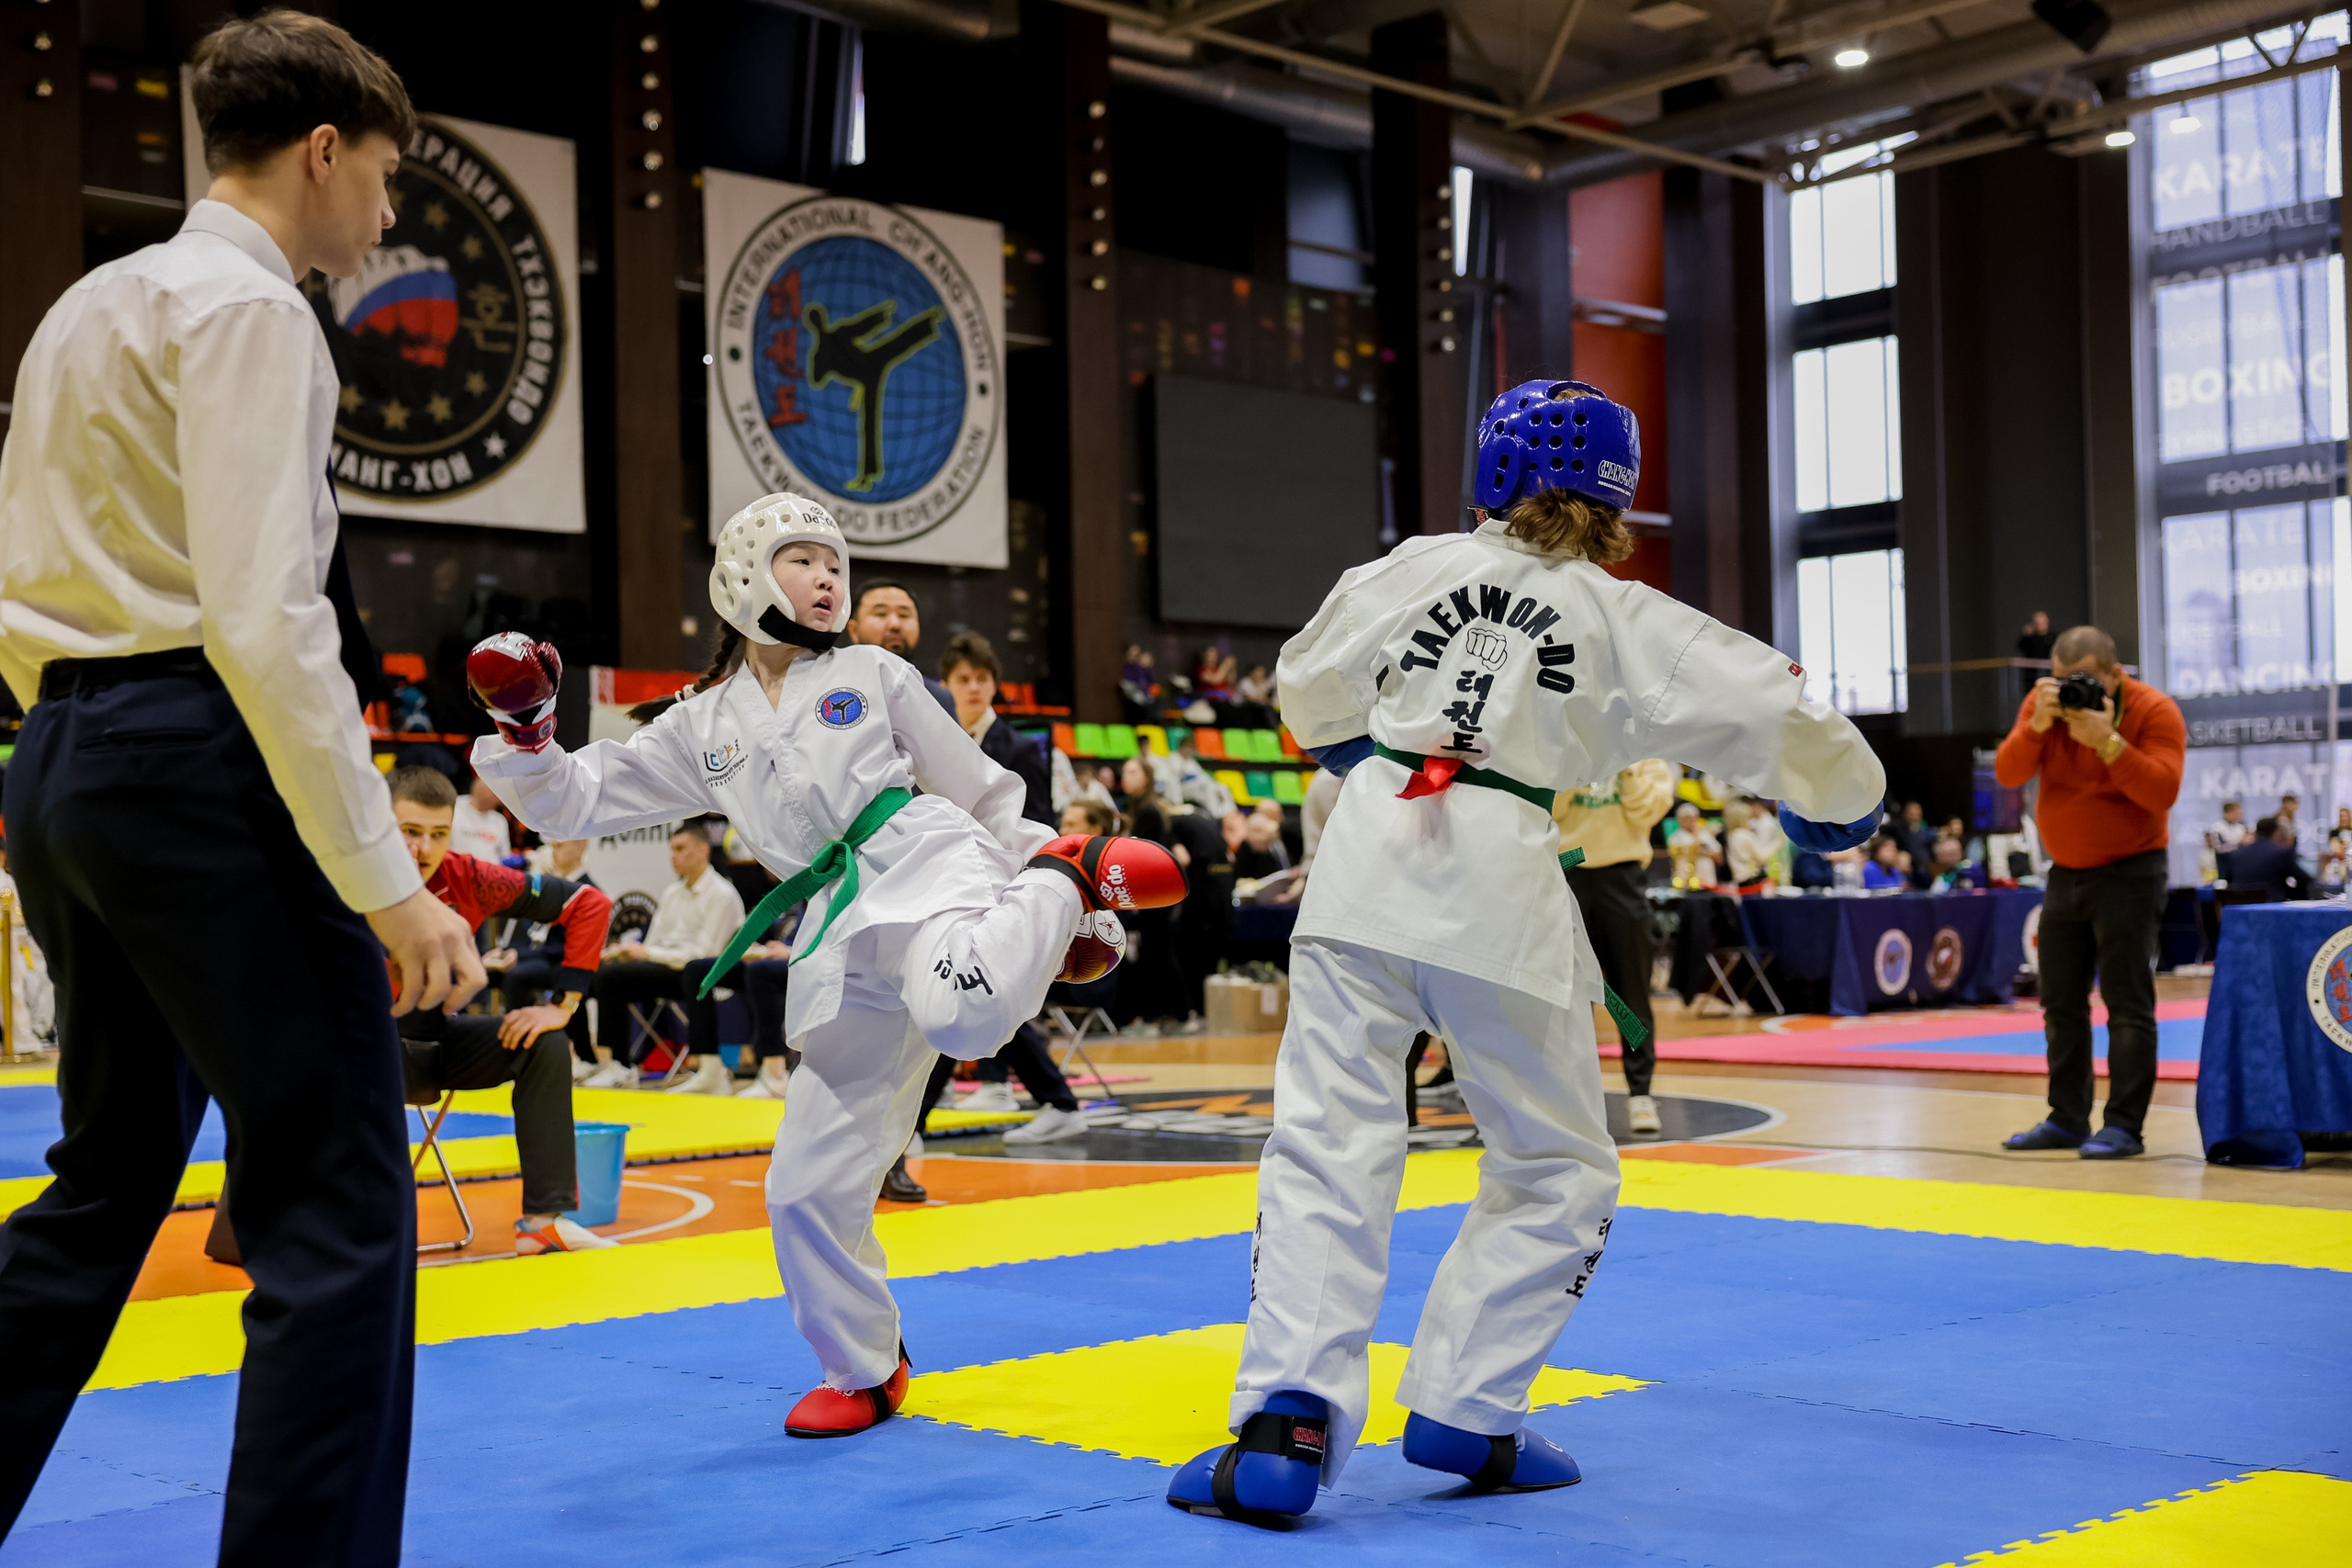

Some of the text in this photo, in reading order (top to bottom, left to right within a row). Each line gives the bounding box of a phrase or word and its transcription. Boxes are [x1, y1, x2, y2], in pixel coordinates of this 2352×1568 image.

[725, 203, 876, 333] INTERNATIONAL
[876, 425, 987, 533] FEDERATION
[2206, 460, 2330, 498] FOOTBAL
[1399, 583, 1576, 694] TAEKWON-DO
[1440, 670, 1495, 754] 태권도
[2184, 715, 2323, 747] ASKETBALL
[2199, 762, 2331, 801] KARAT
